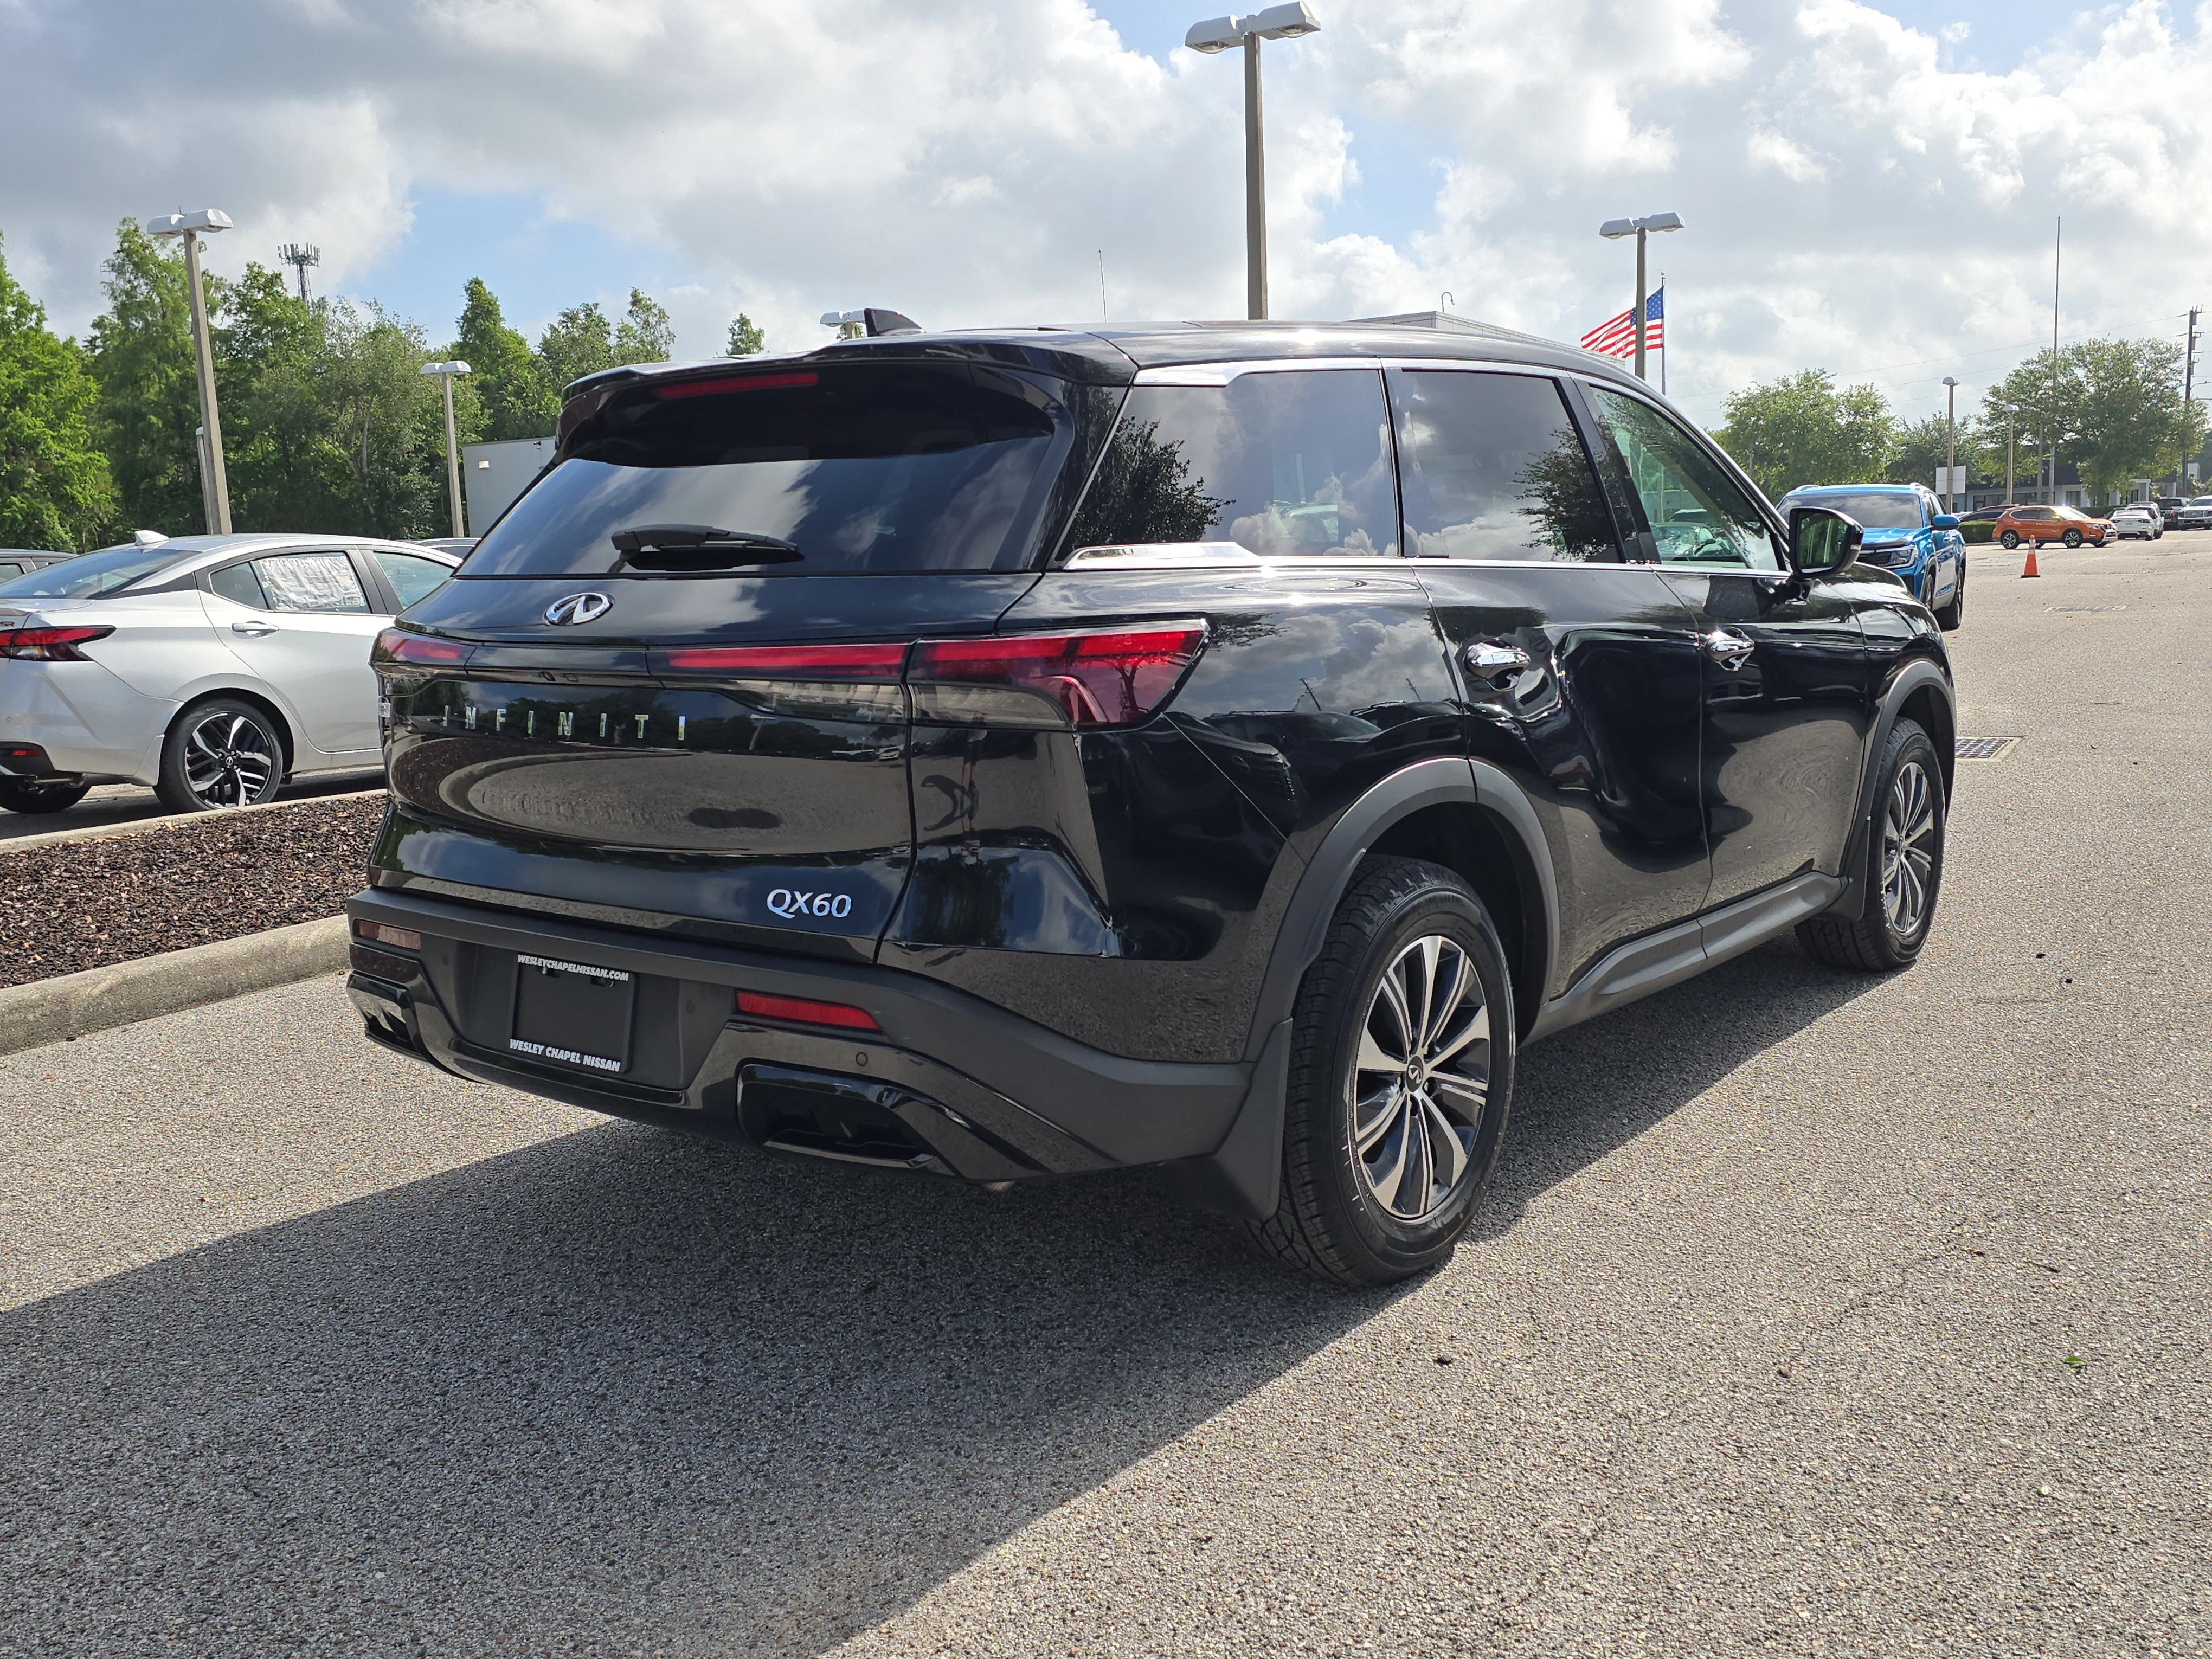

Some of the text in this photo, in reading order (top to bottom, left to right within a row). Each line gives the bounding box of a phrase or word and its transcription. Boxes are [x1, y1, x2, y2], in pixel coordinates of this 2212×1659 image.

[443, 705, 685, 741] INFINITI
[767, 889, 852, 919] QX60
[518, 954, 629, 981] WESLEYCHAPELNISSAN.COM
[510, 1039, 621, 1072] WESLEY CHAPEL NISSAN
